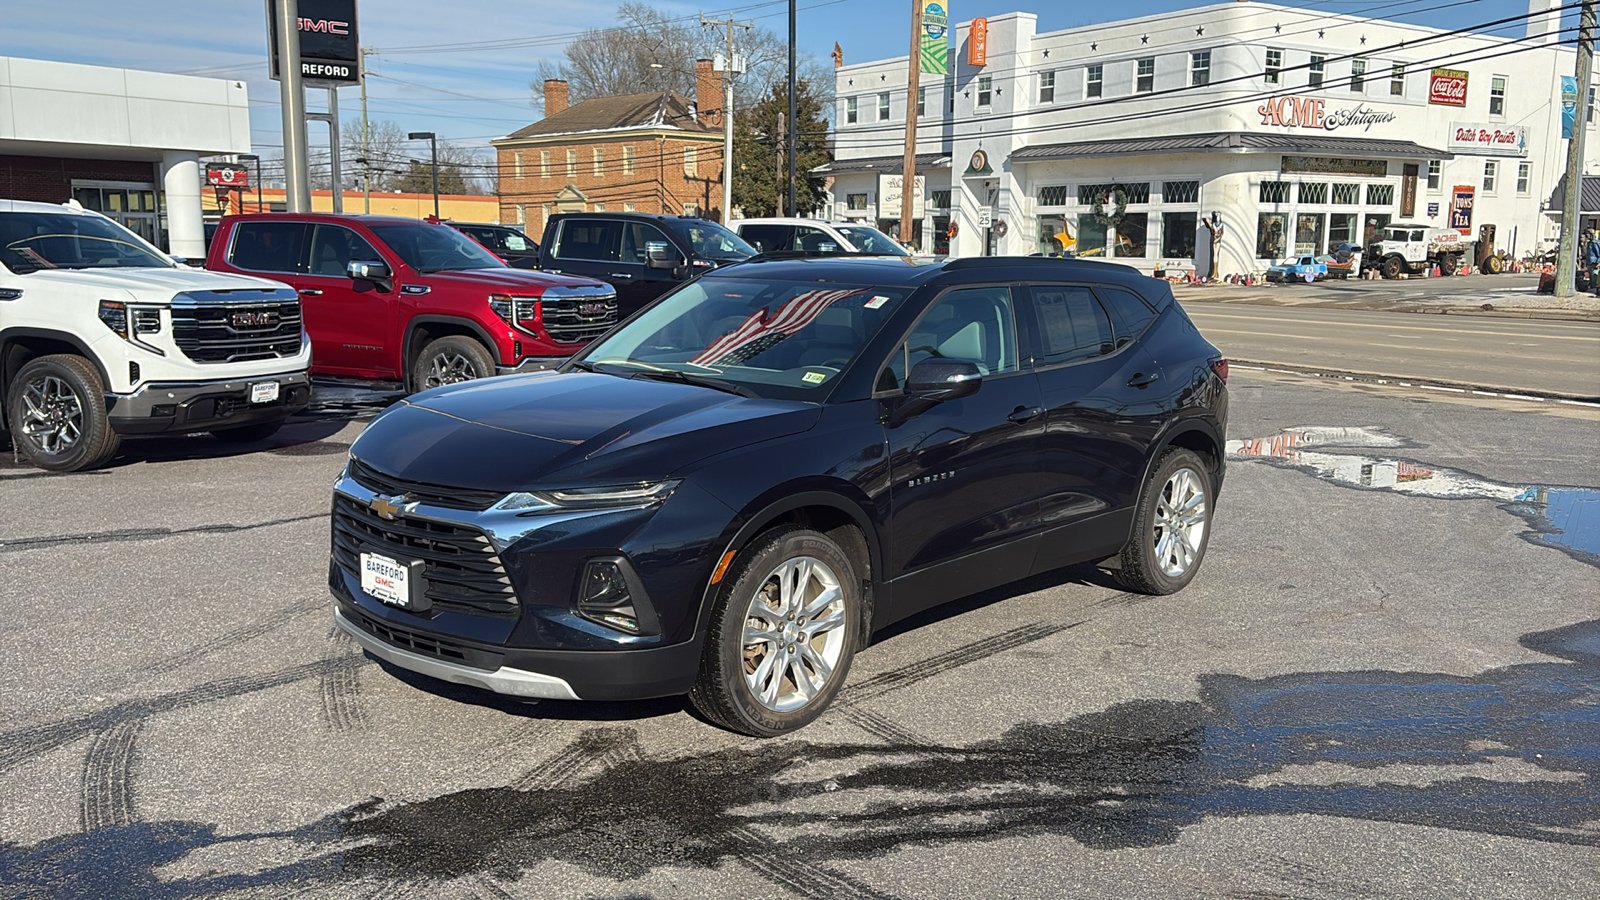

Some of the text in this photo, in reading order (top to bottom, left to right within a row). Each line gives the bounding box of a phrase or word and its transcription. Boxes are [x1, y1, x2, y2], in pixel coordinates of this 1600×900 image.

[976, 21, 984, 62] ACME
[301, 63, 349, 77] REFORD
[1258, 96, 1325, 128] ACME
[1339, 102, 1396, 132] Antiques
[1455, 128, 1516, 146] Dutch Boy Paints
[979, 217, 990, 225] 25
[1434, 234, 1458, 242] ACME
[1305, 266, 1314, 274] 43
[580, 303, 606, 314] GMC
[233, 312, 279, 326] GMC
[908, 470, 955, 488] BLAZER
[366, 560, 405, 582] BAREFORD
[375, 576, 395, 589] GMC
[745, 704, 786, 729] NEXEN
